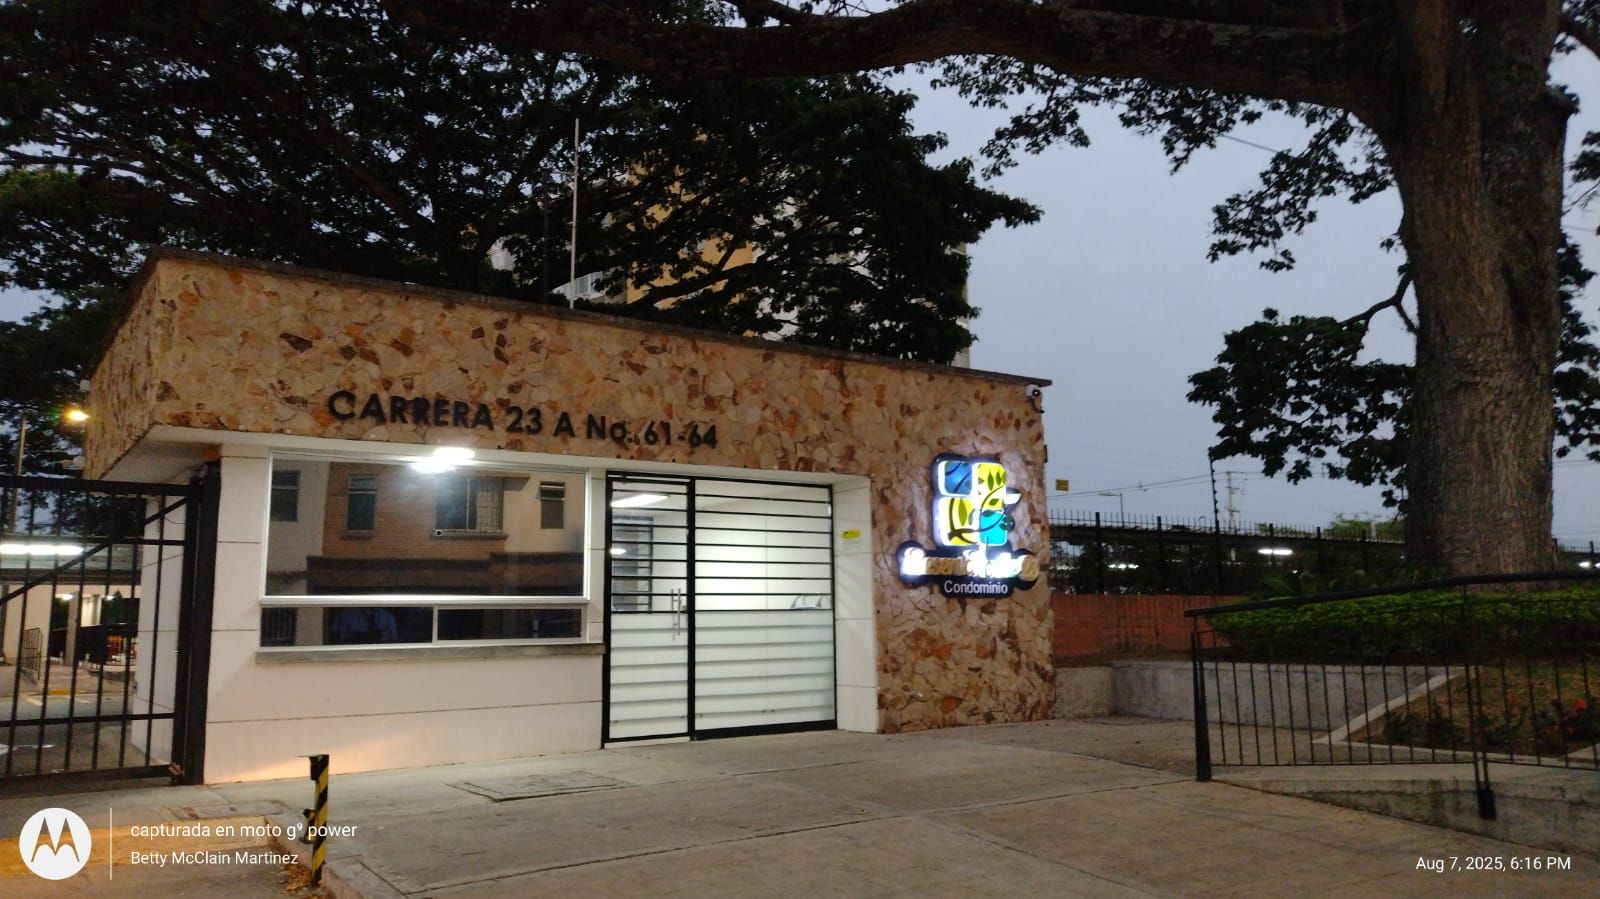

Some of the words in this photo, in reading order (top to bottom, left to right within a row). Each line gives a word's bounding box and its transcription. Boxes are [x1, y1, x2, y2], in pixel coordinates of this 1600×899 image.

[327, 389, 494, 431] CARRERA
[505, 405, 543, 435] 23
[552, 411, 576, 438] A
[644, 420, 718, 449] 61-64
[943, 580, 1008, 594] Condominio
